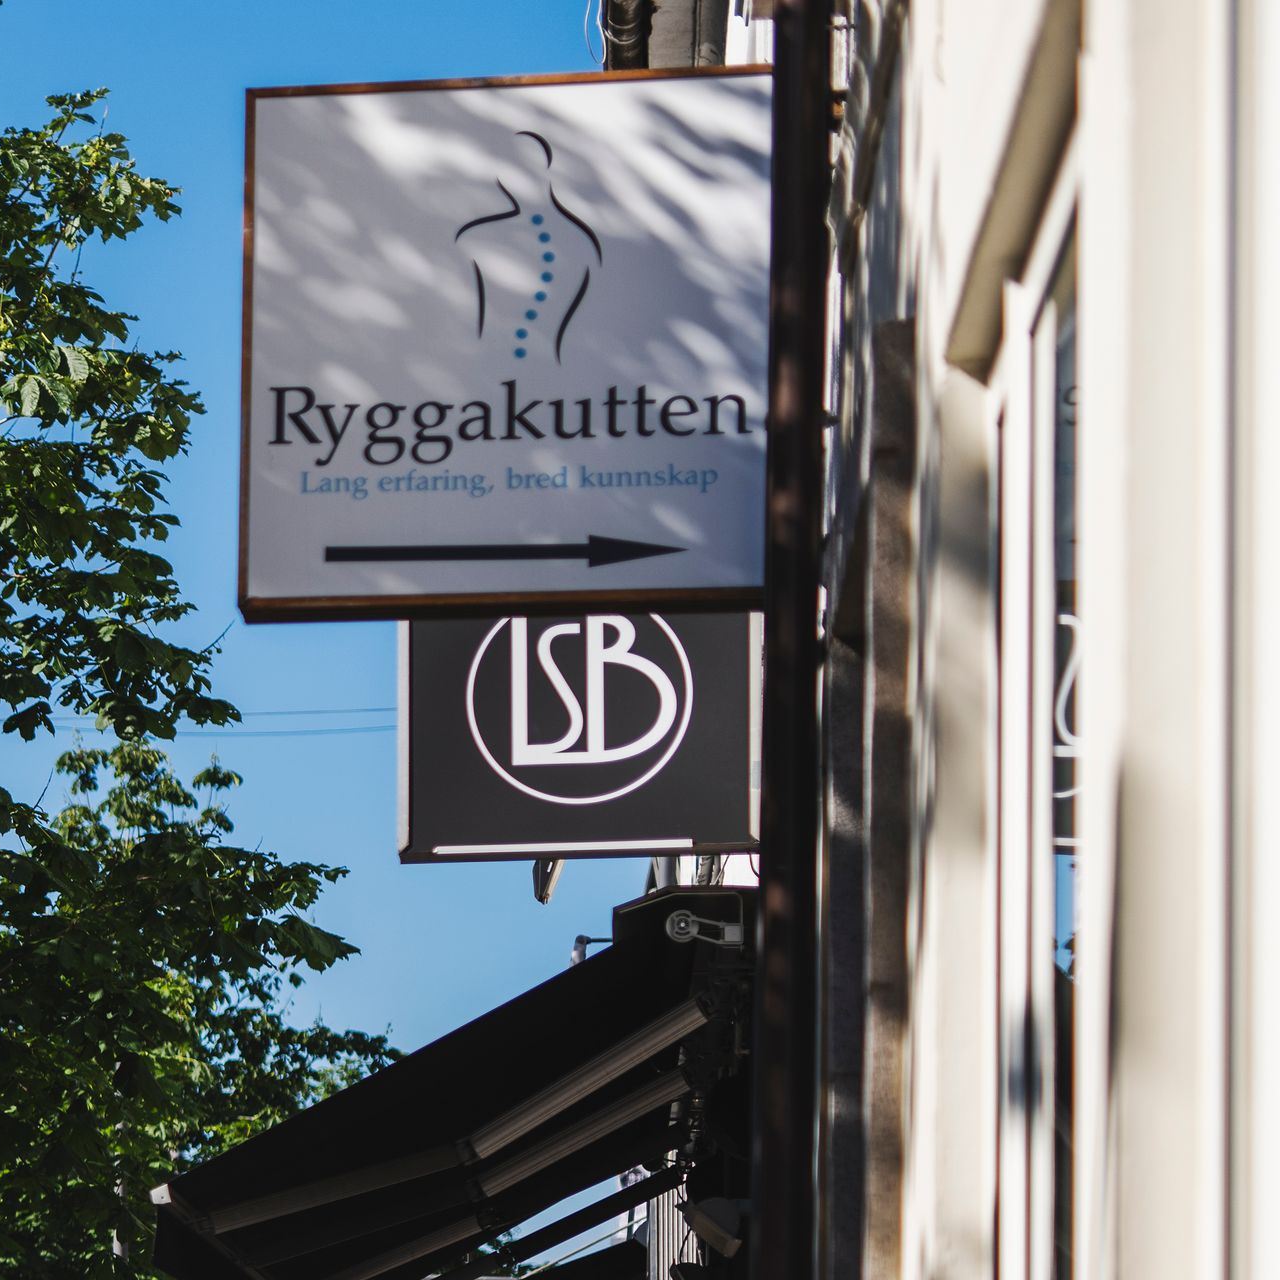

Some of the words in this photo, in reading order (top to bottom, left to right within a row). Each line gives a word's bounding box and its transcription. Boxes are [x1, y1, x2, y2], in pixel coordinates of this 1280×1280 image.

[268, 379, 753, 467] Ryggakutten
[300, 471, 369, 499] Lang
[378, 468, 495, 496] erfaring,
[506, 465, 569, 490] bred
[578, 463, 720, 493] kunnskap
